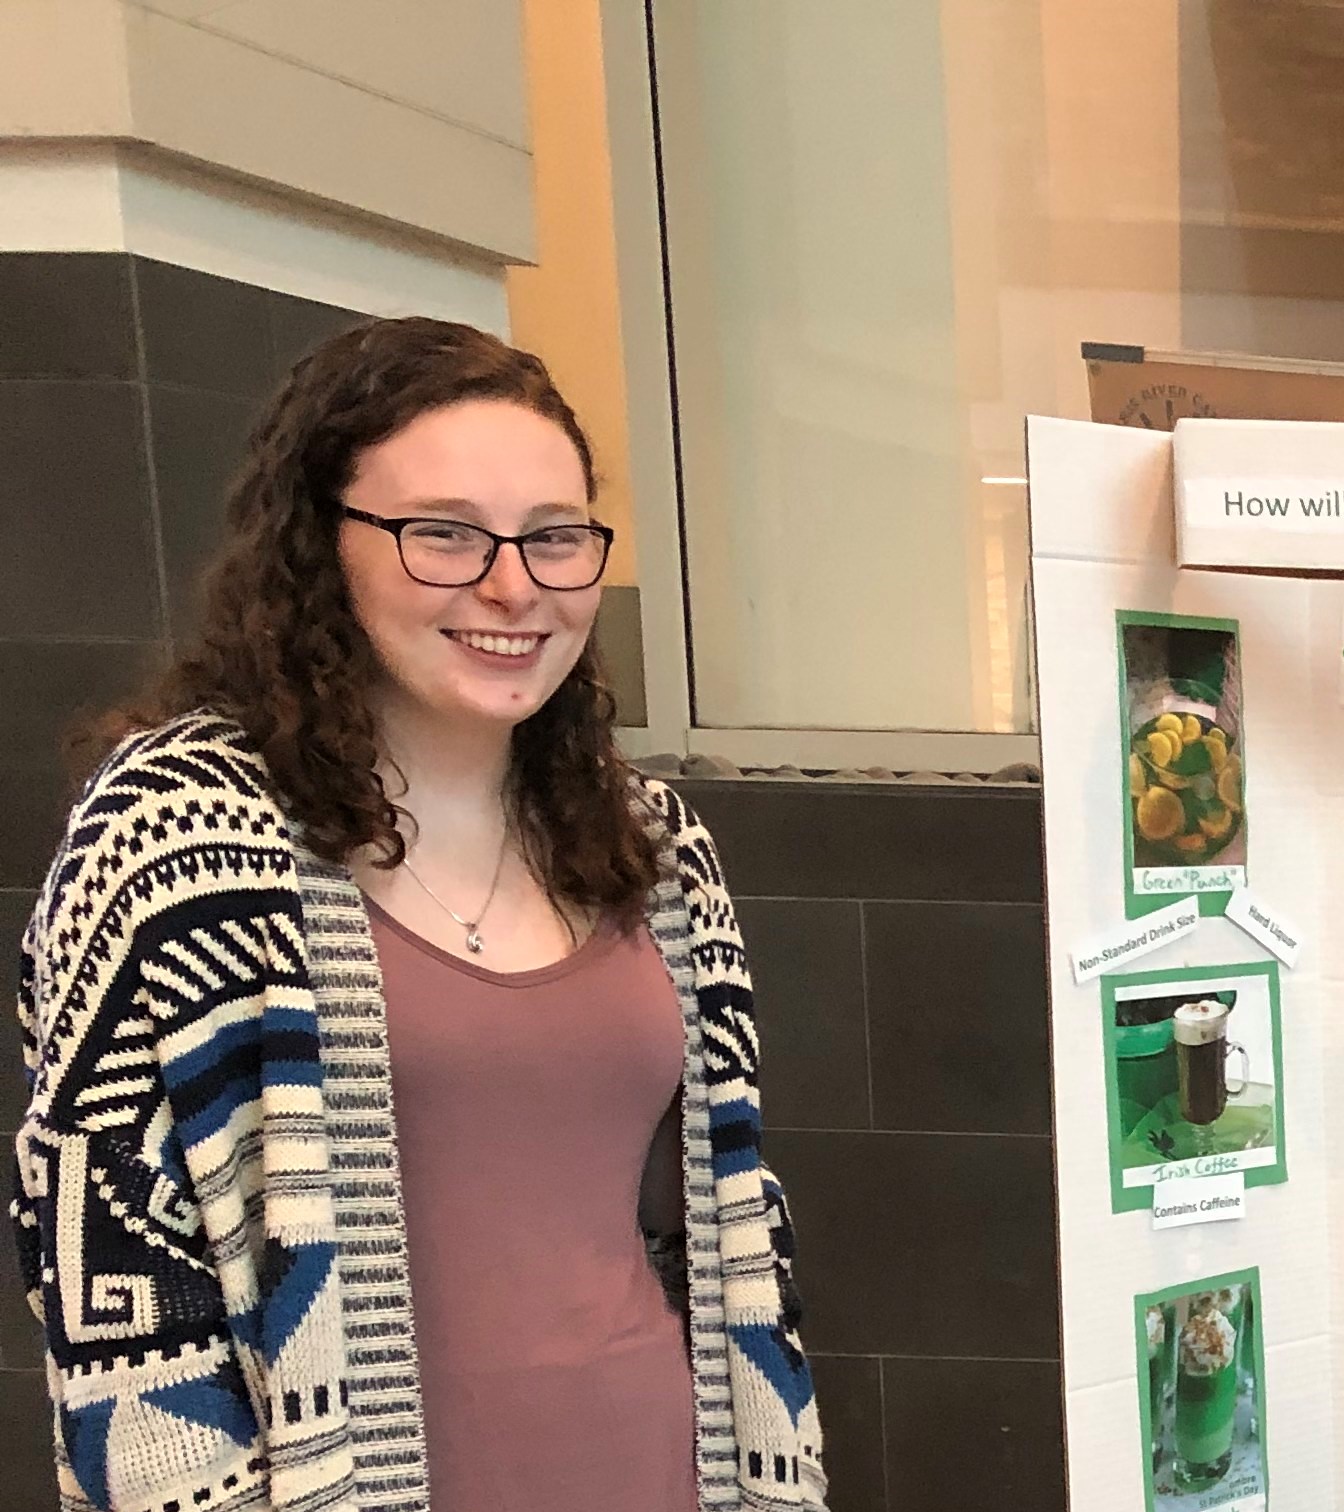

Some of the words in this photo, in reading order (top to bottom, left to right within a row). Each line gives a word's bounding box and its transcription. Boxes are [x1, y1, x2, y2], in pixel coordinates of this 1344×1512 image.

[1223, 491, 1290, 518] How
[1142, 869, 1184, 891] Green
[1247, 904, 1272, 930] Hard
[1269, 924, 1299, 950] Liquor
[1078, 931, 1149, 973] Non-Standard
[1149, 918, 1177, 942] Drink
[1176, 912, 1197, 930] Size
[1152, 1165, 1191, 1183] Irish
[1195, 1155, 1239, 1175] Coffee
[1154, 1202, 1198, 1219] Contains
[1199, 1196, 1241, 1212] Caffeine
